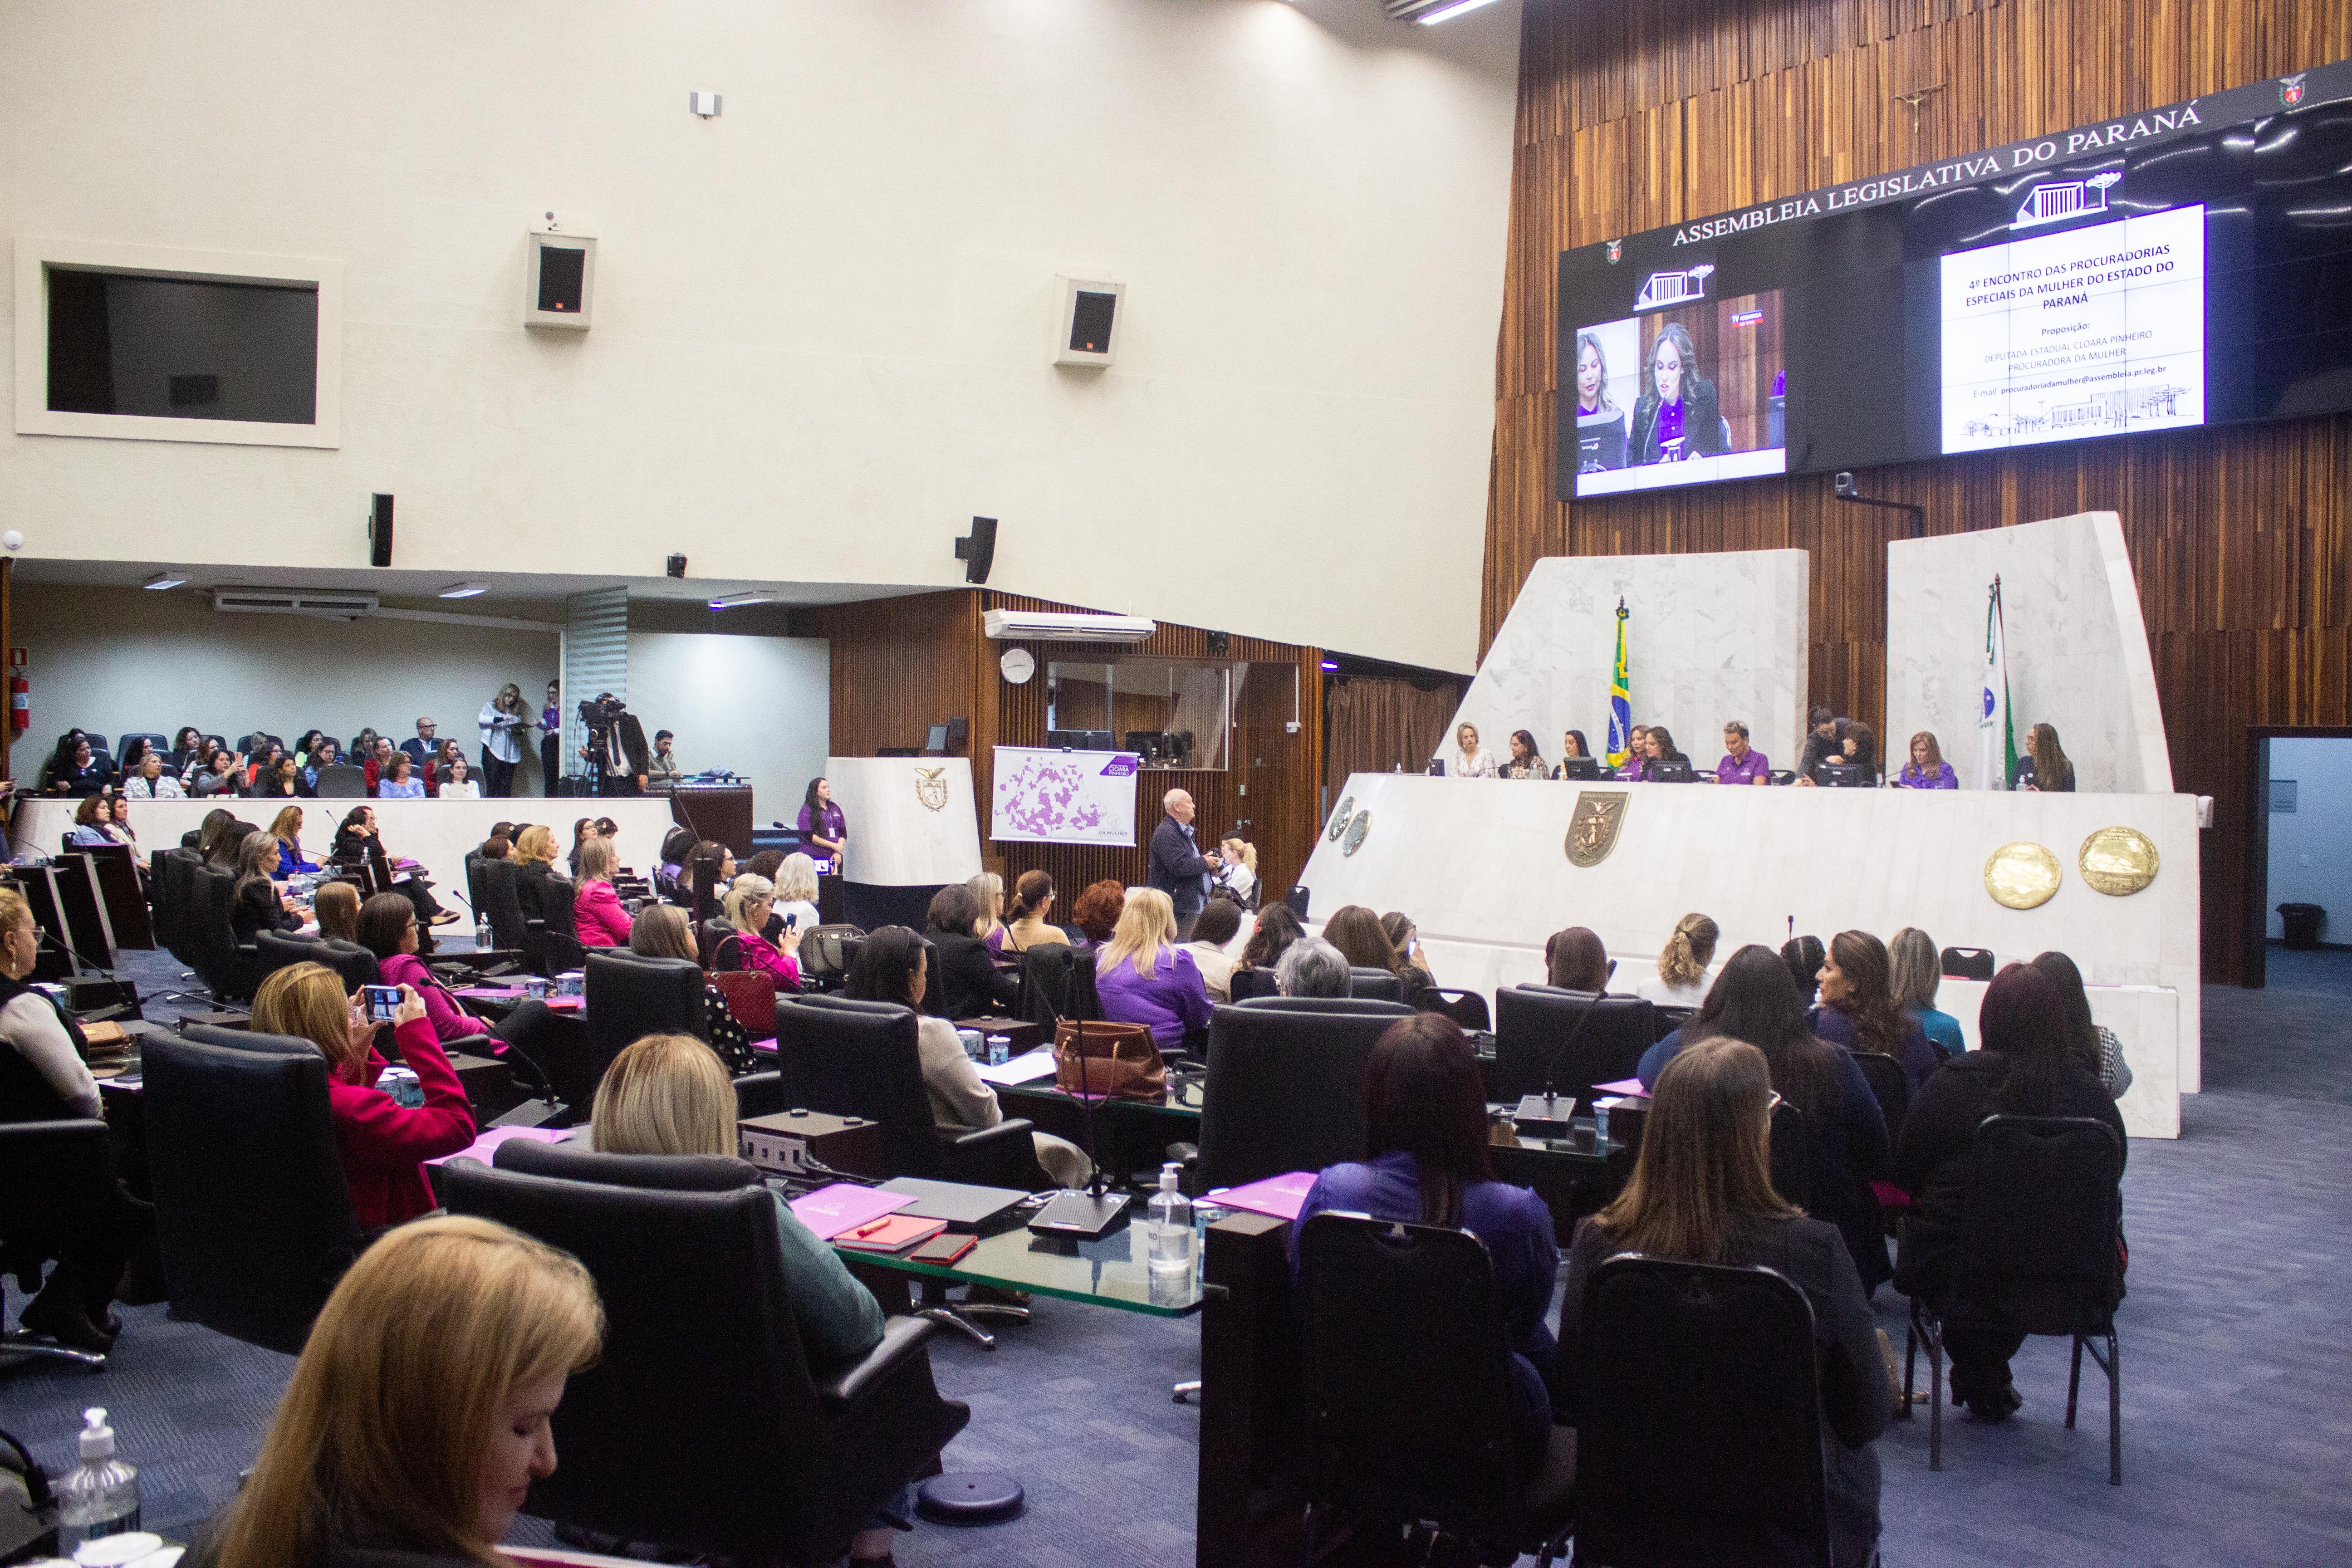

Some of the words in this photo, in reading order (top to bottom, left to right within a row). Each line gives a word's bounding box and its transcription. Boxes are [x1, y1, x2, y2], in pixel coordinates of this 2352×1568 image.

[1672, 197, 1821, 246] ASSEMBLEIA
[1828, 154, 2002, 211] LEGISLATIVA
[2012, 141, 2056, 167] DO
[2067, 99, 2202, 154] PARANÁ
[1984, 269, 2042, 287] ENCONTRO
[2045, 264, 2067, 276] DAS
[2070, 244, 2170, 271] PROCURADORIAS
[1966, 289, 2015, 306] ESPECIAIS
[2019, 287, 2034, 297] DA
[2038, 278, 2083, 294] MULHER
[2087, 274, 2104, 285] DO
[2108, 265, 2152, 281] ESTADO
[2156, 261, 2174, 273] DO
[2043, 290, 2088, 309] PARANÁ
[2042, 323, 2090, 336] Proposição:
[1985, 350, 2027, 363] DEPUTADA
[2030, 343, 2071, 356] ESTADUAL
[2074, 338, 2107, 349] CLOARA
[2110, 330, 2152, 343] PINHEIRO
[2009, 356, 2071, 372] PROCURADORA
[2074, 354, 2086, 363] DA
[2089, 348, 2126, 360] MULHER
